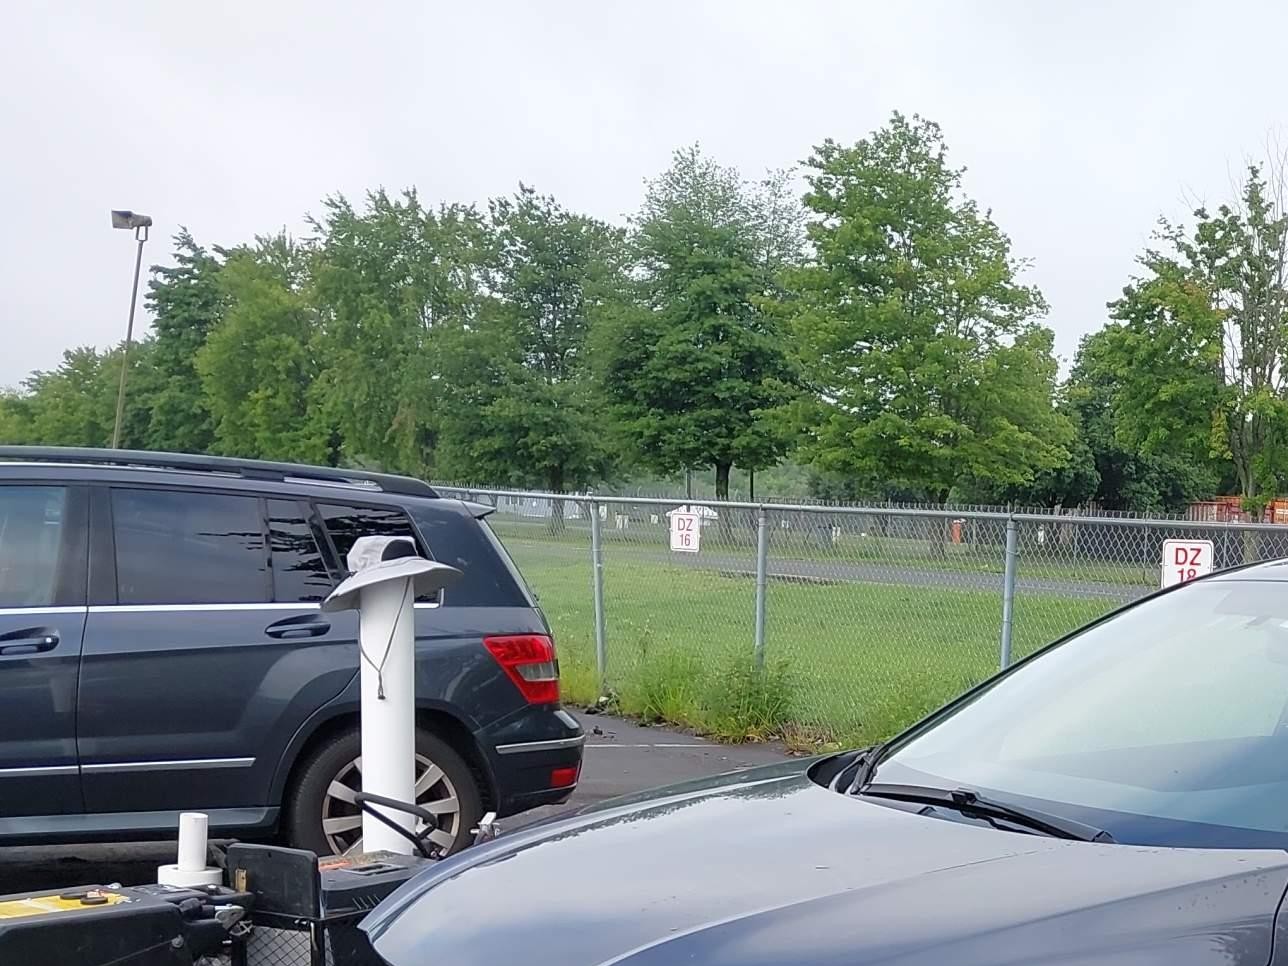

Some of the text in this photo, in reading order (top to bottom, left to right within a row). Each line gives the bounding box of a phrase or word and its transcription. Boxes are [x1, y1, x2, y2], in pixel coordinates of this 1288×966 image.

[677, 518, 693, 531] DZ
[680, 534, 691, 546] 16
[1175, 548, 1202, 566] DZ
